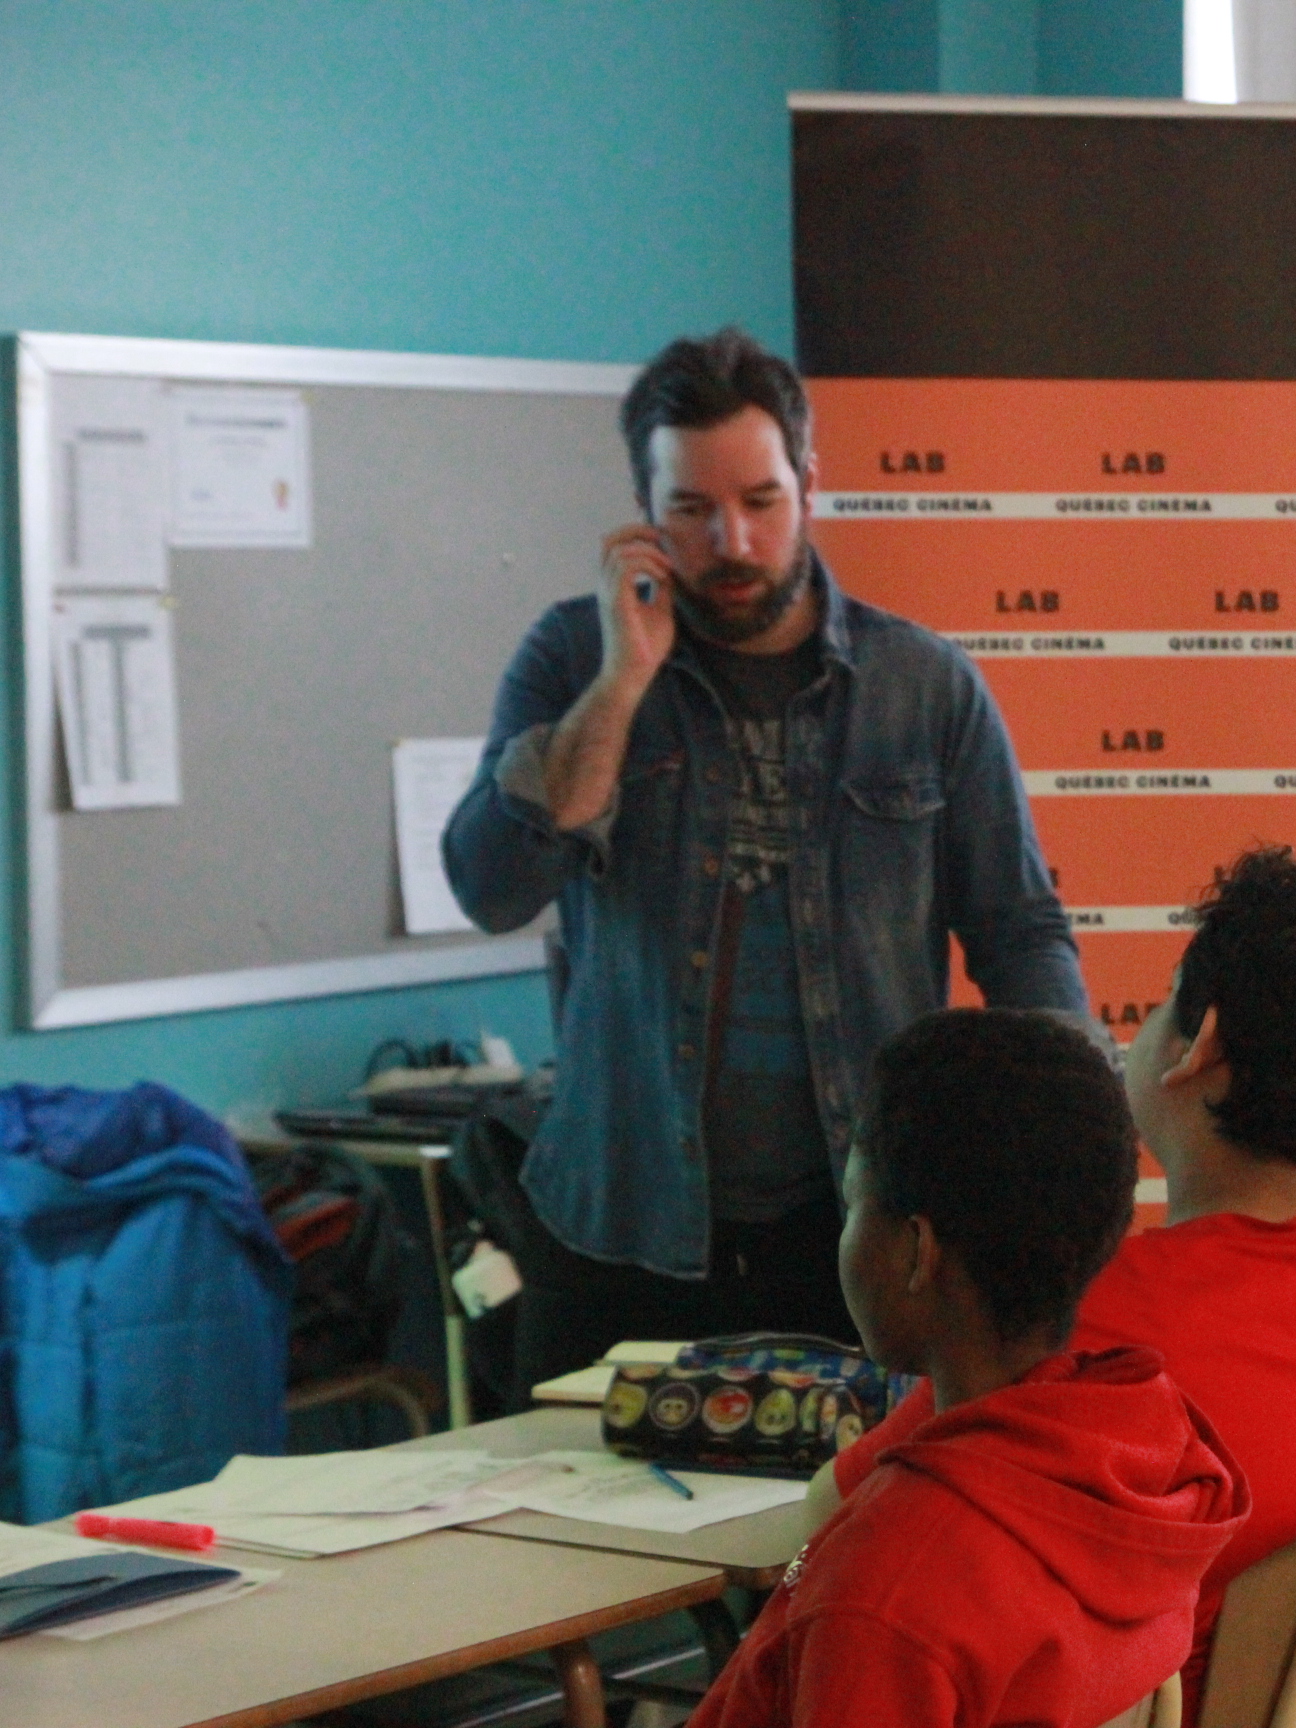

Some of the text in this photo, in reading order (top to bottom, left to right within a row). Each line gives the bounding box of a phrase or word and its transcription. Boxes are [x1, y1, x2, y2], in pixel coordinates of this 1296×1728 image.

[880, 452, 945, 474] LAB
[1101, 452, 1165, 475] LAB
[995, 590, 1060, 613] LAB
[1215, 590, 1280, 613] LAB
[1102, 729, 1165, 752] LAB
